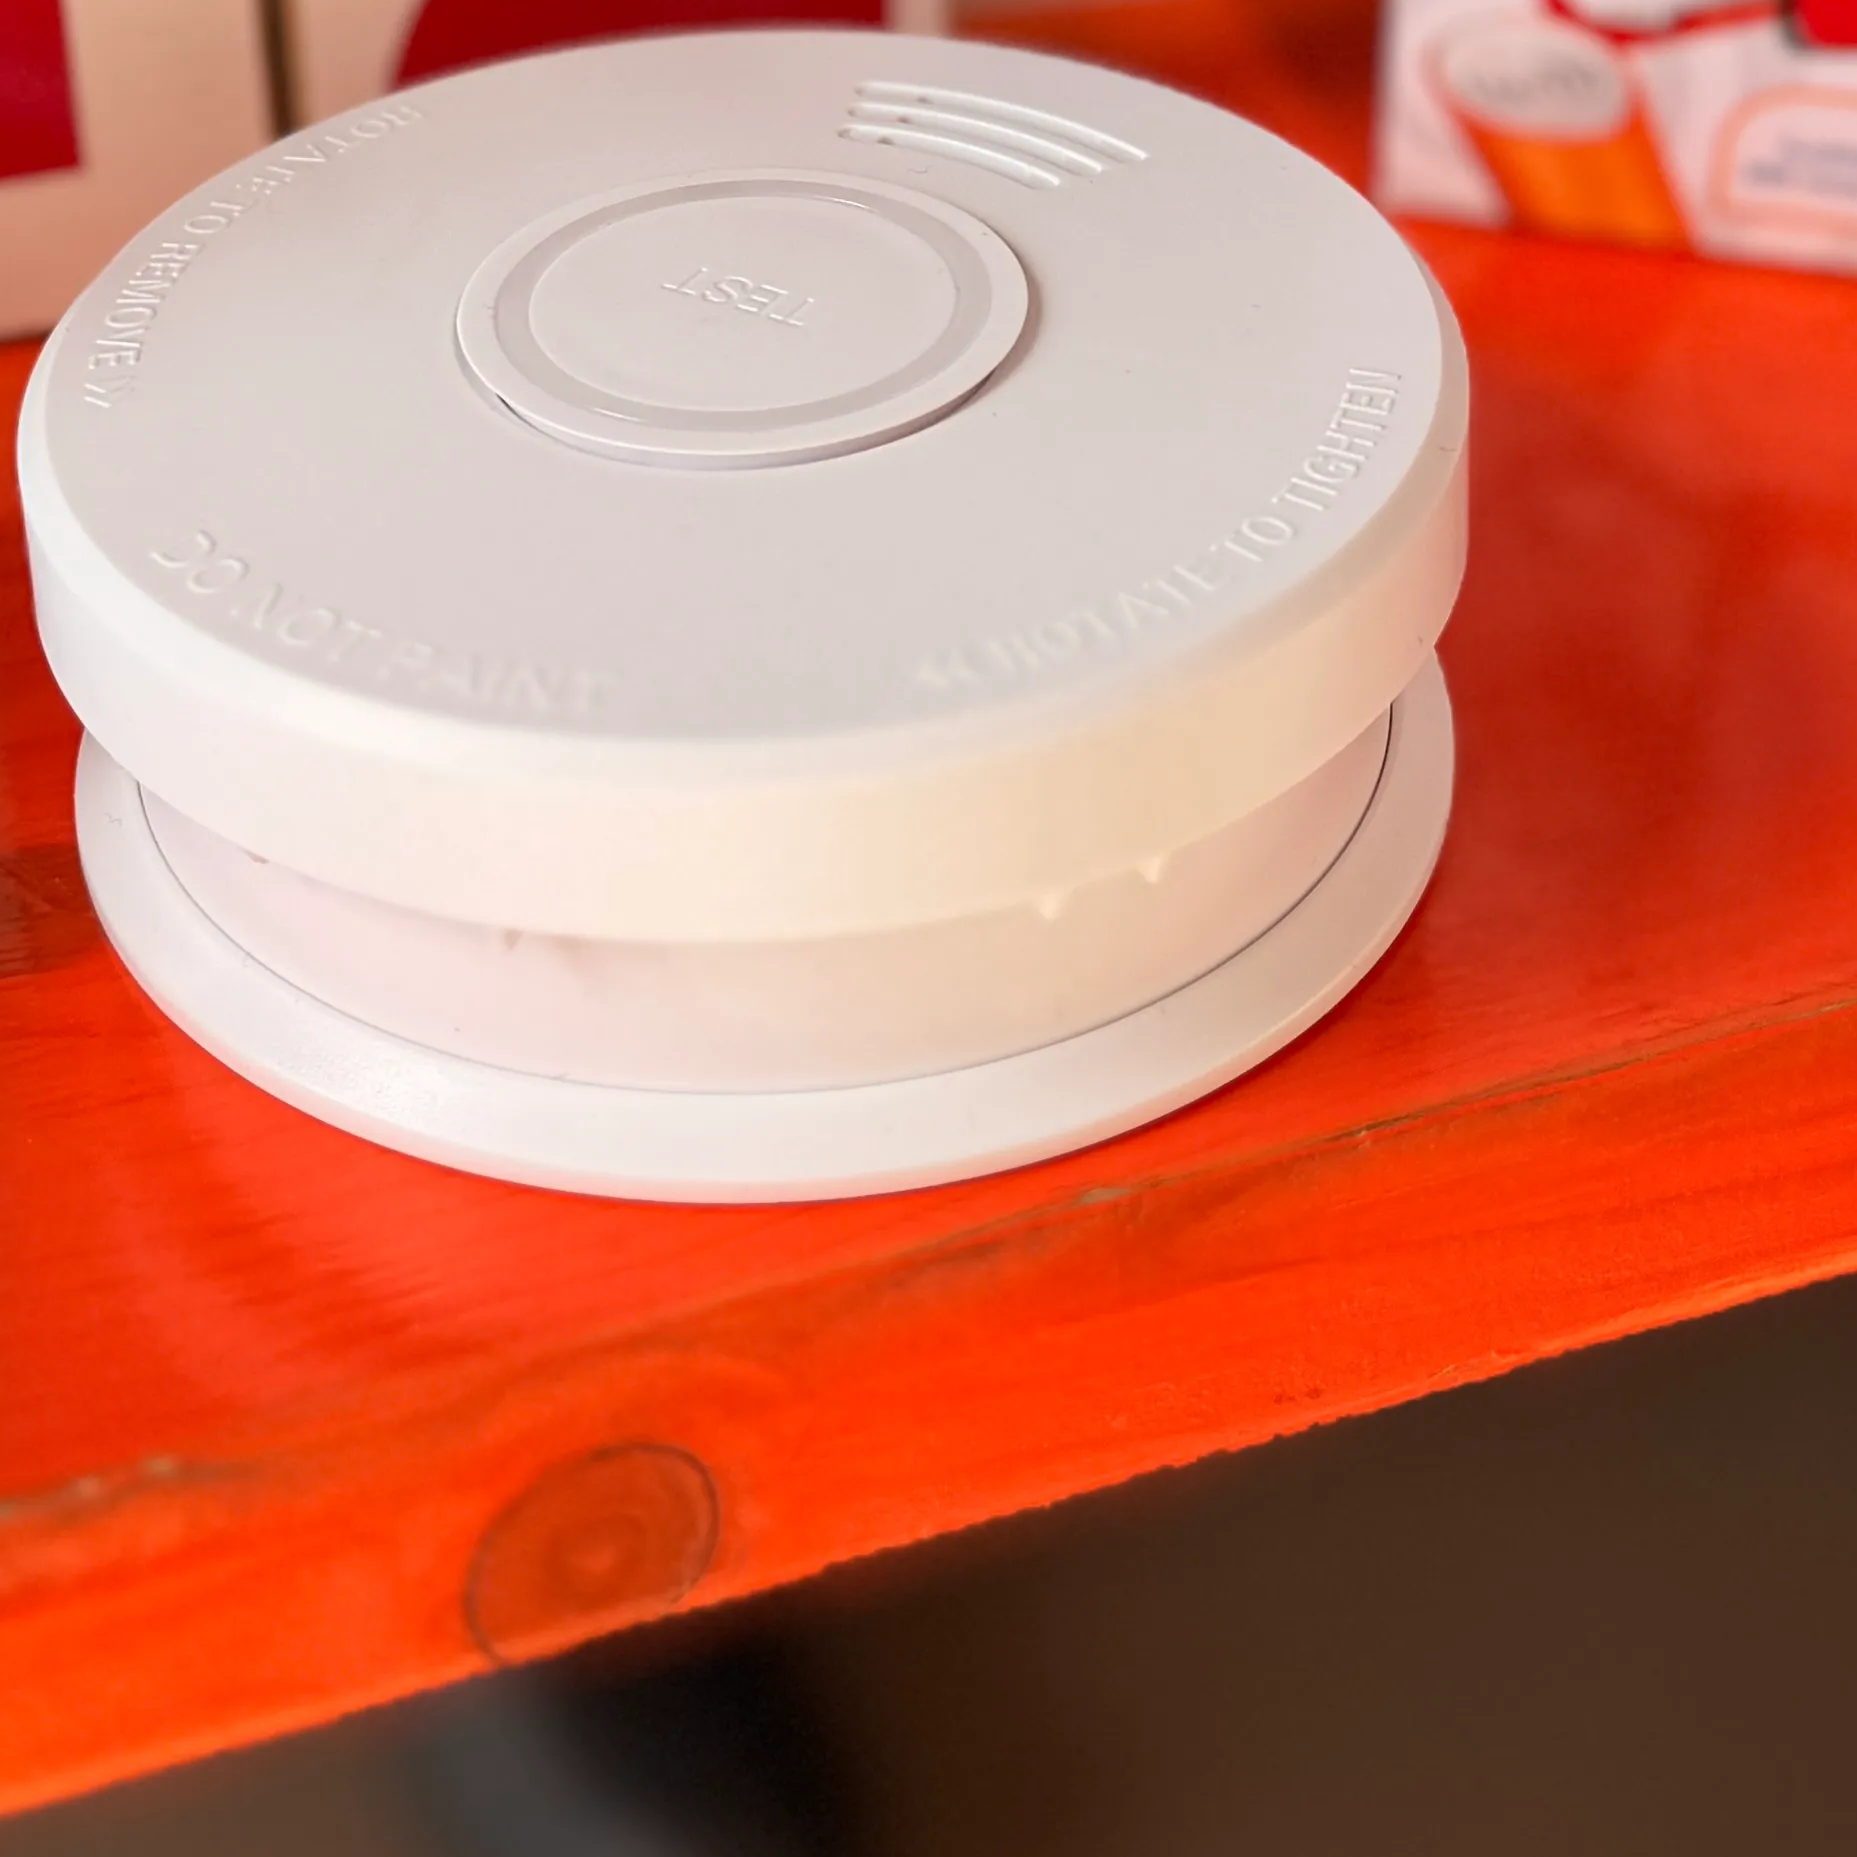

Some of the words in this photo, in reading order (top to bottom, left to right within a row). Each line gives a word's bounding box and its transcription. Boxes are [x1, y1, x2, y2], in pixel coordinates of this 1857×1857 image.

[236, 104, 424, 197] ROTATE
[182, 198, 258, 235] TO
[87, 241, 207, 371] REMOVE
[660, 265, 816, 327] TEST
[1209, 514, 1296, 564] TO
[1270, 366, 1404, 513] TIGHTEN
[148, 528, 251, 595] DO
[228, 581, 383, 663] NOT
